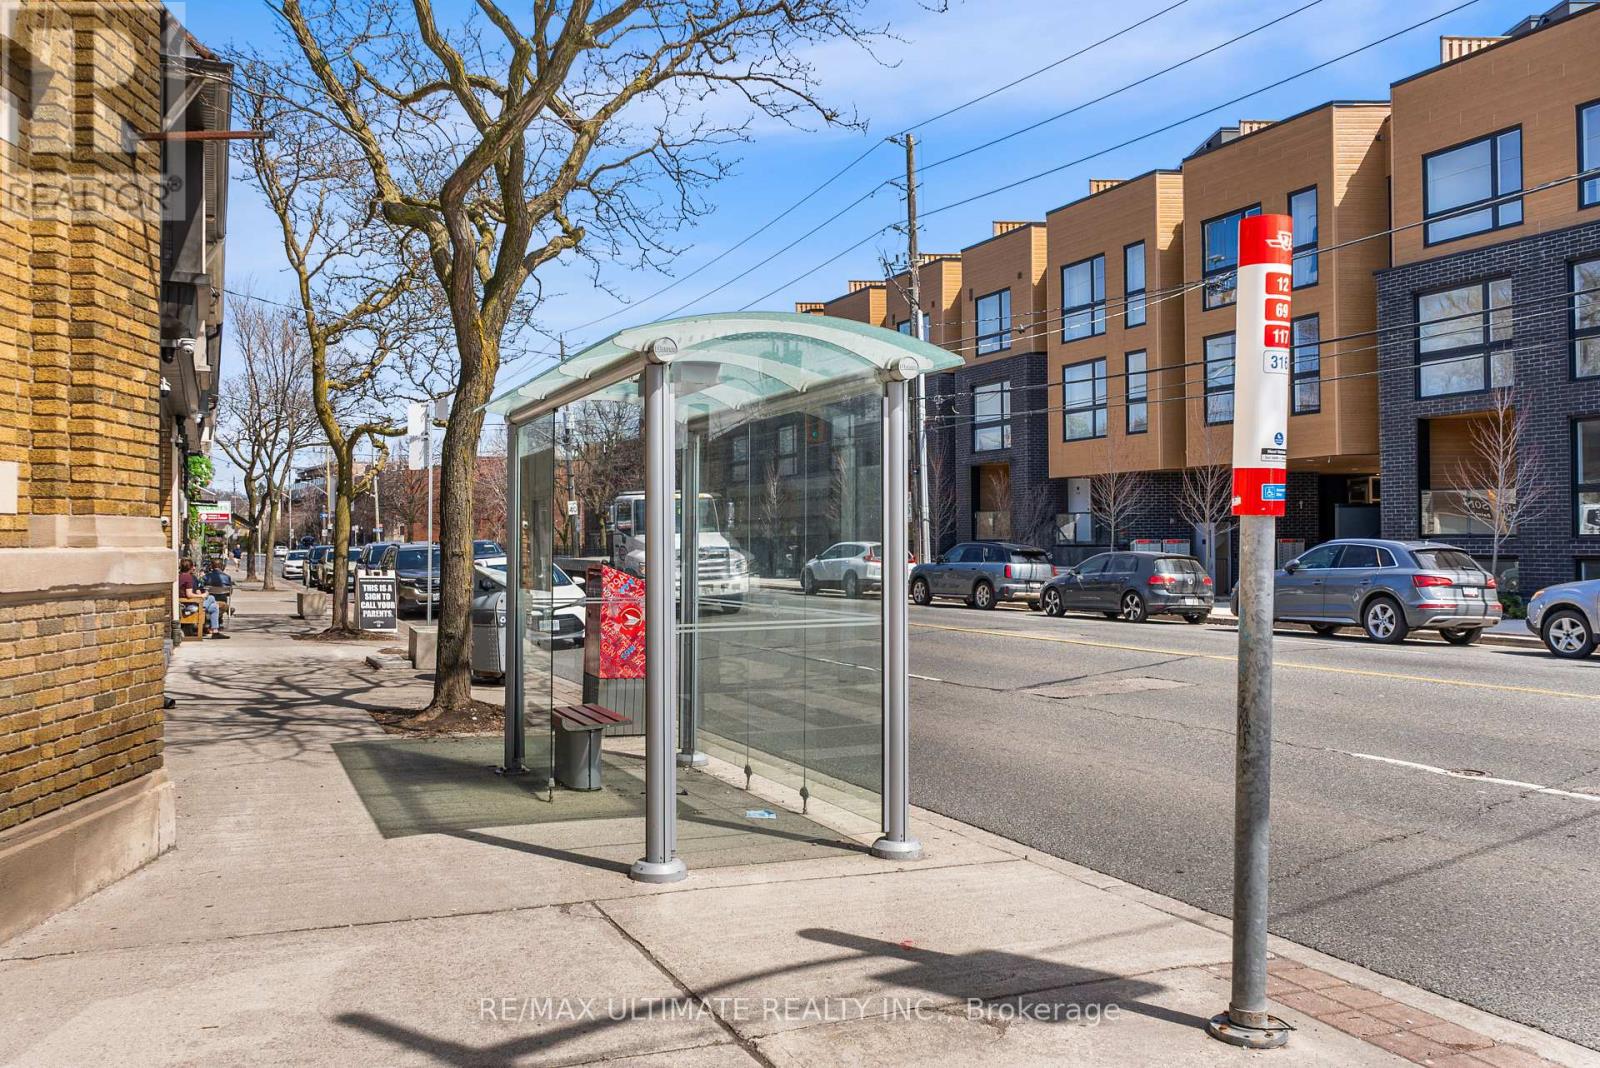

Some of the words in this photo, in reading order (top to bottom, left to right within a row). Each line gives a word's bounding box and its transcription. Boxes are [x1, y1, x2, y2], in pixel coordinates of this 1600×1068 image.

[1277, 277, 1289, 292] 12
[1275, 303, 1289, 318] 69
[1272, 328, 1289, 344] 117
[362, 584, 379, 592] THIS
[380, 584, 387, 592] IS
[388, 584, 393, 592] A
[364, 592, 381, 601] SIGN
[382, 592, 391, 601] TO
[360, 601, 376, 609] CALL
[377, 601, 396, 609] YOUR
